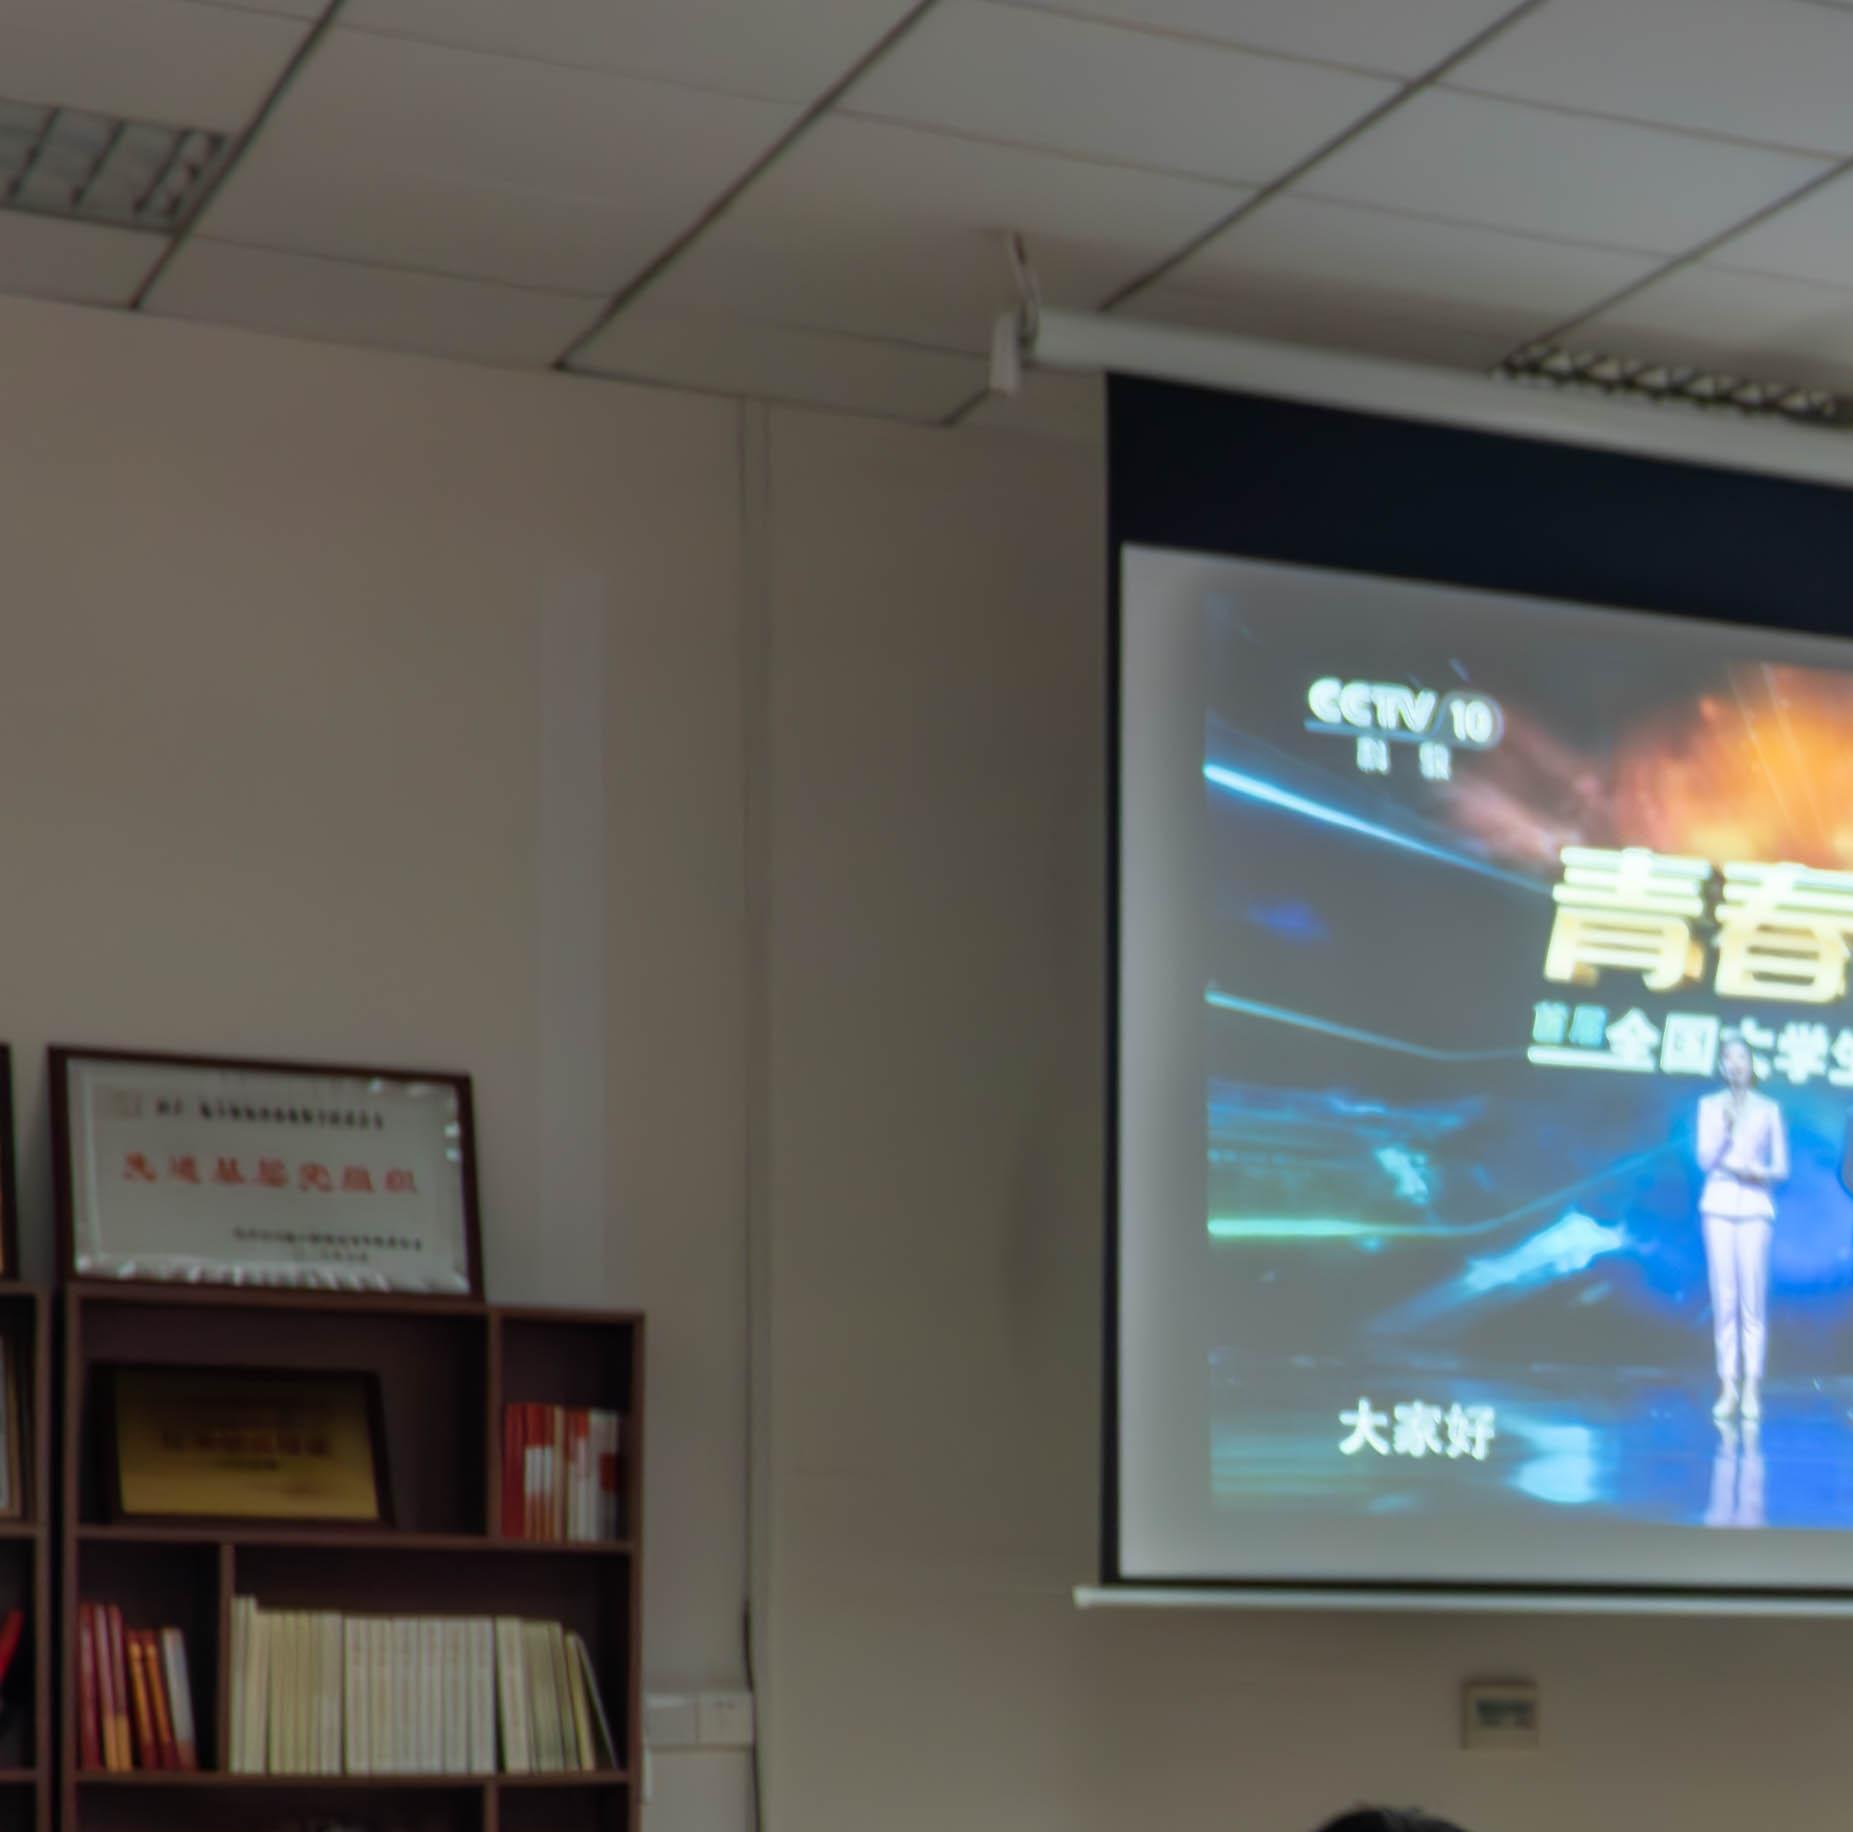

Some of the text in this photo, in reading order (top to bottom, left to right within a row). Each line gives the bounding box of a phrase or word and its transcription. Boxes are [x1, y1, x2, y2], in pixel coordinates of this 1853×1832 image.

[1308, 677, 1488, 743] CCTV 10
[1338, 1397, 1495, 1461] 大家好
